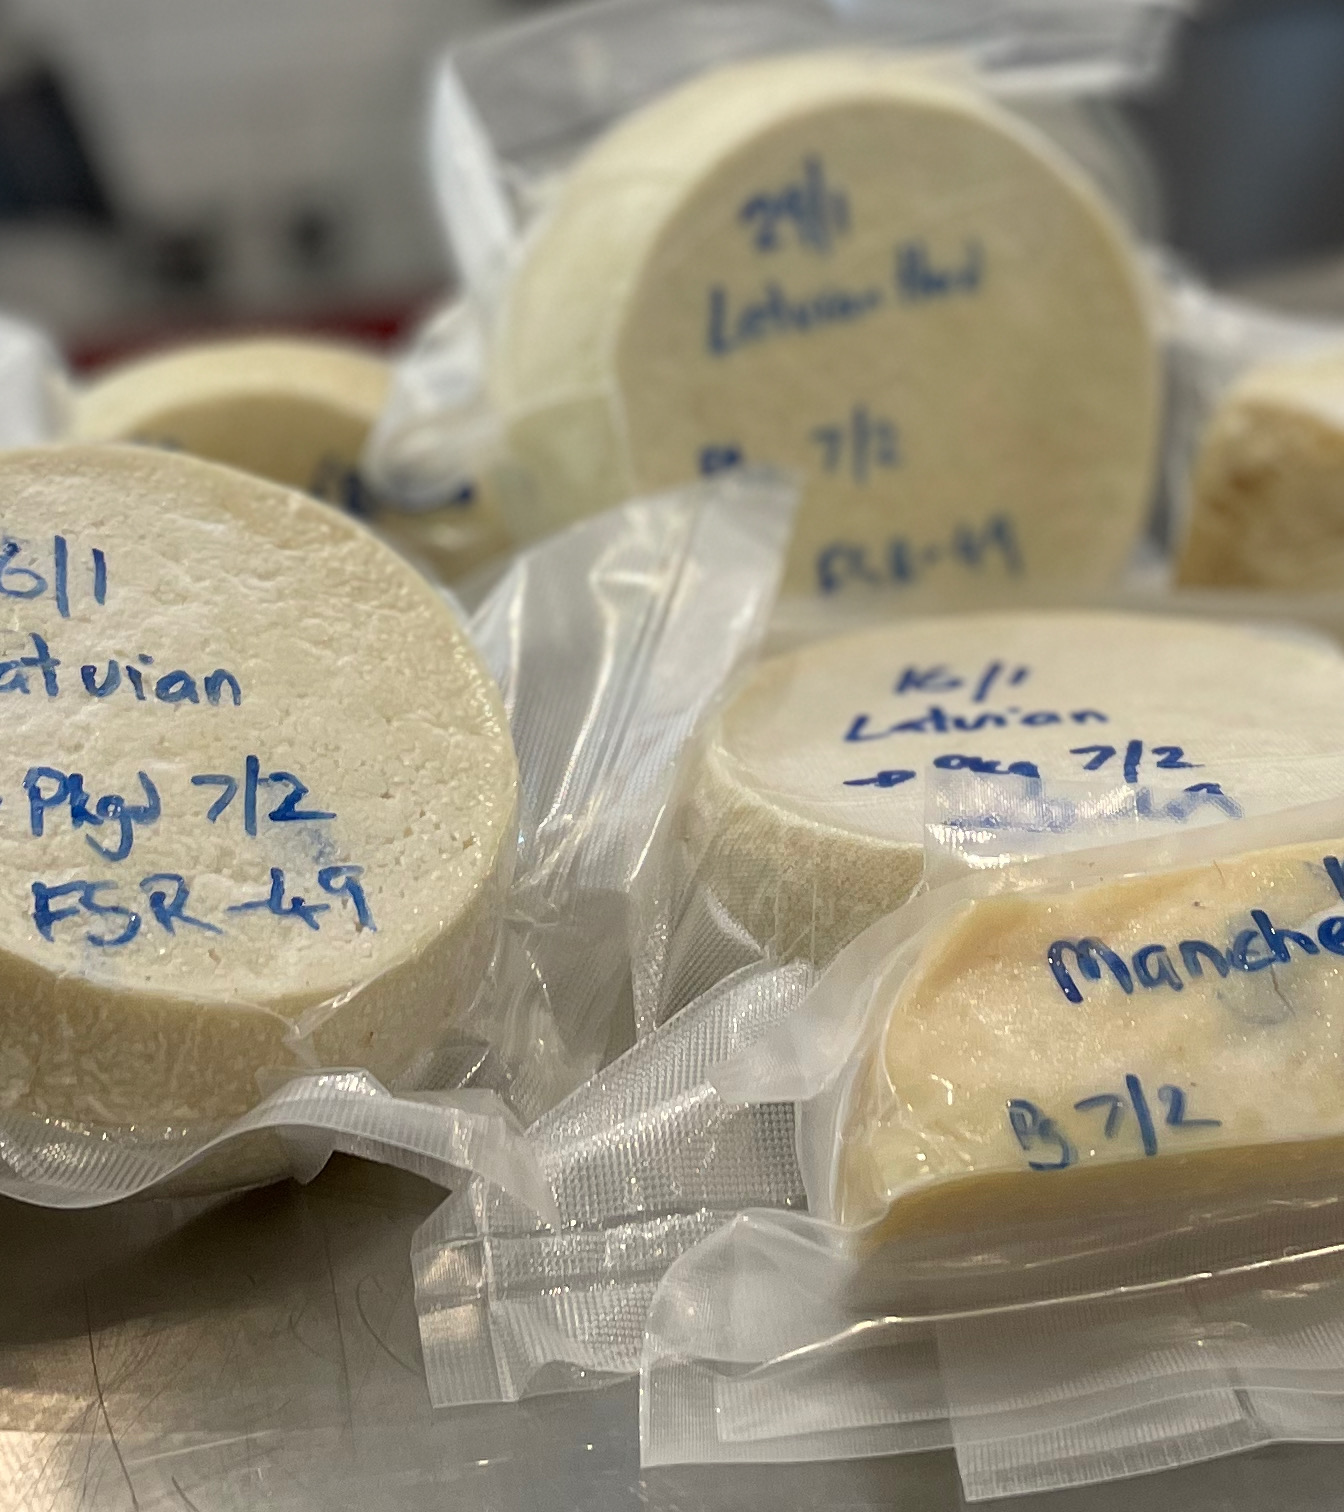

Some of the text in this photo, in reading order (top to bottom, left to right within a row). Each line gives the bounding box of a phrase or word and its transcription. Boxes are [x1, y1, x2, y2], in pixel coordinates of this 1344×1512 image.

[842, 704, 1110, 744] Latvian
[1068, 738, 1207, 785] 7/2
[189, 753, 338, 838] 7/2
[29, 864, 378, 950] FSR-49
[1072, 1071, 1224, 1158] 7/2
